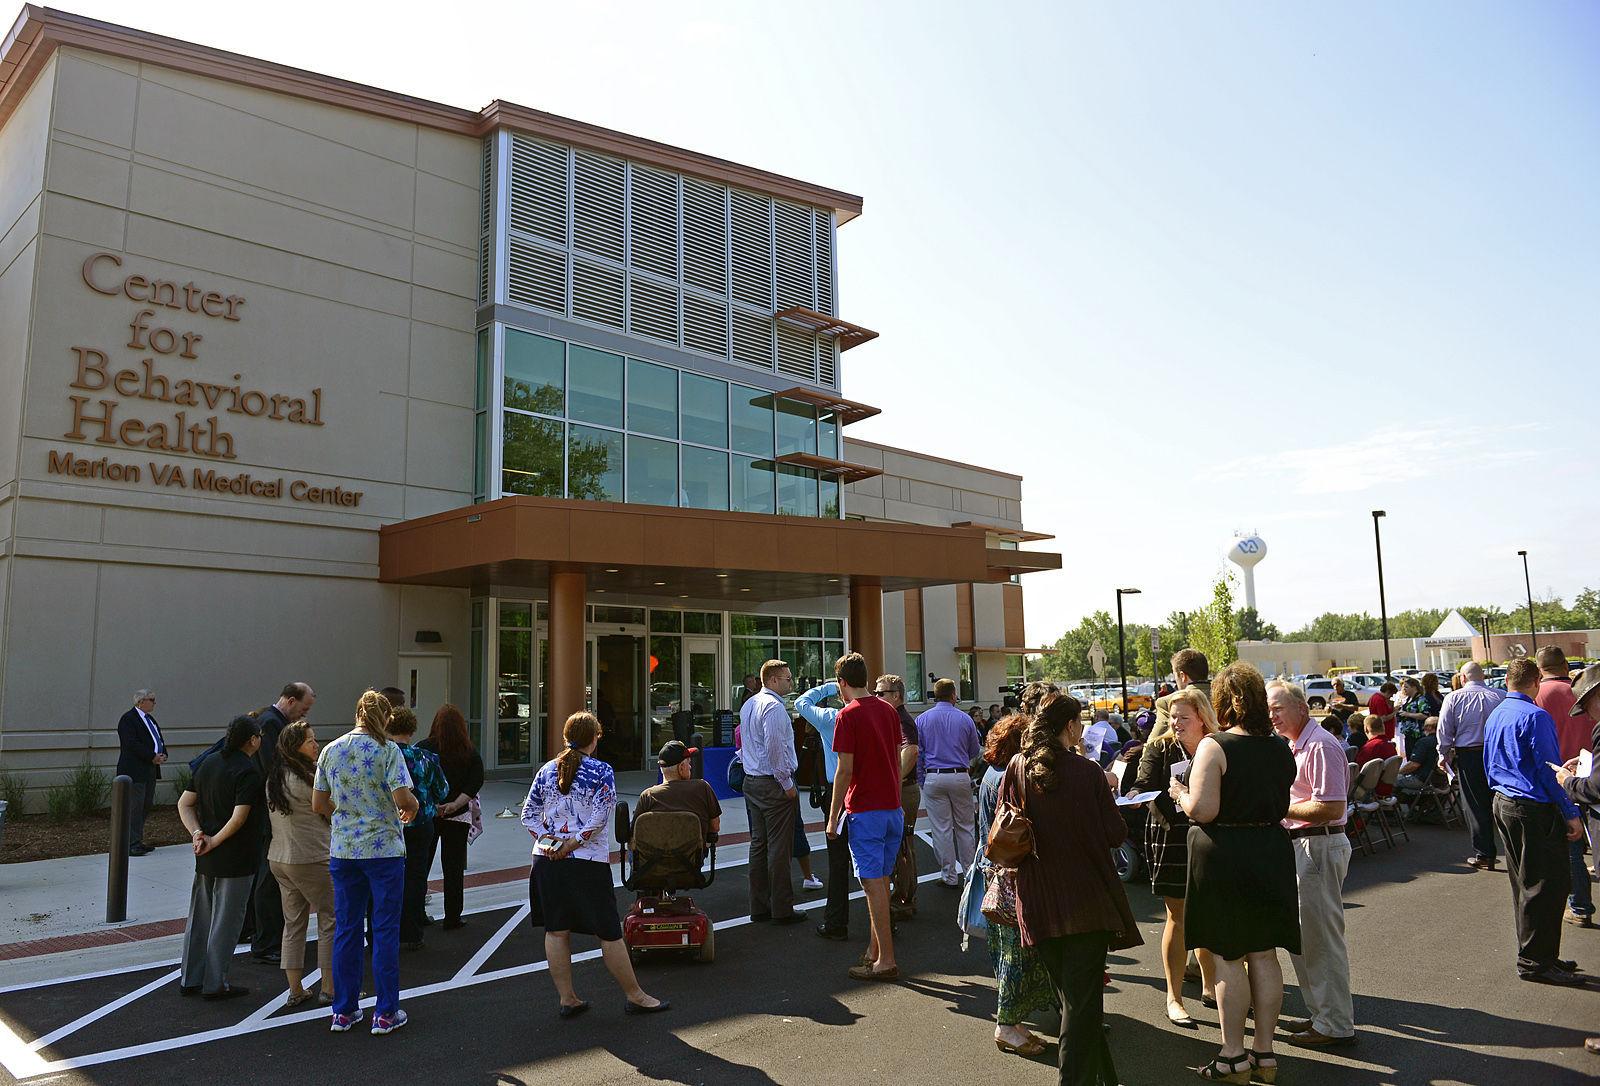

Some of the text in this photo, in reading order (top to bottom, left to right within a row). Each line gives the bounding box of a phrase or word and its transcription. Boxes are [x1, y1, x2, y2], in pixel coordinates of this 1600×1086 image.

[82, 252, 246, 321] Center
[127, 309, 202, 359] for
[70, 346, 325, 426] Behavioral
[64, 395, 237, 459] Health
[48, 450, 363, 507] Marion VA Medical Center
